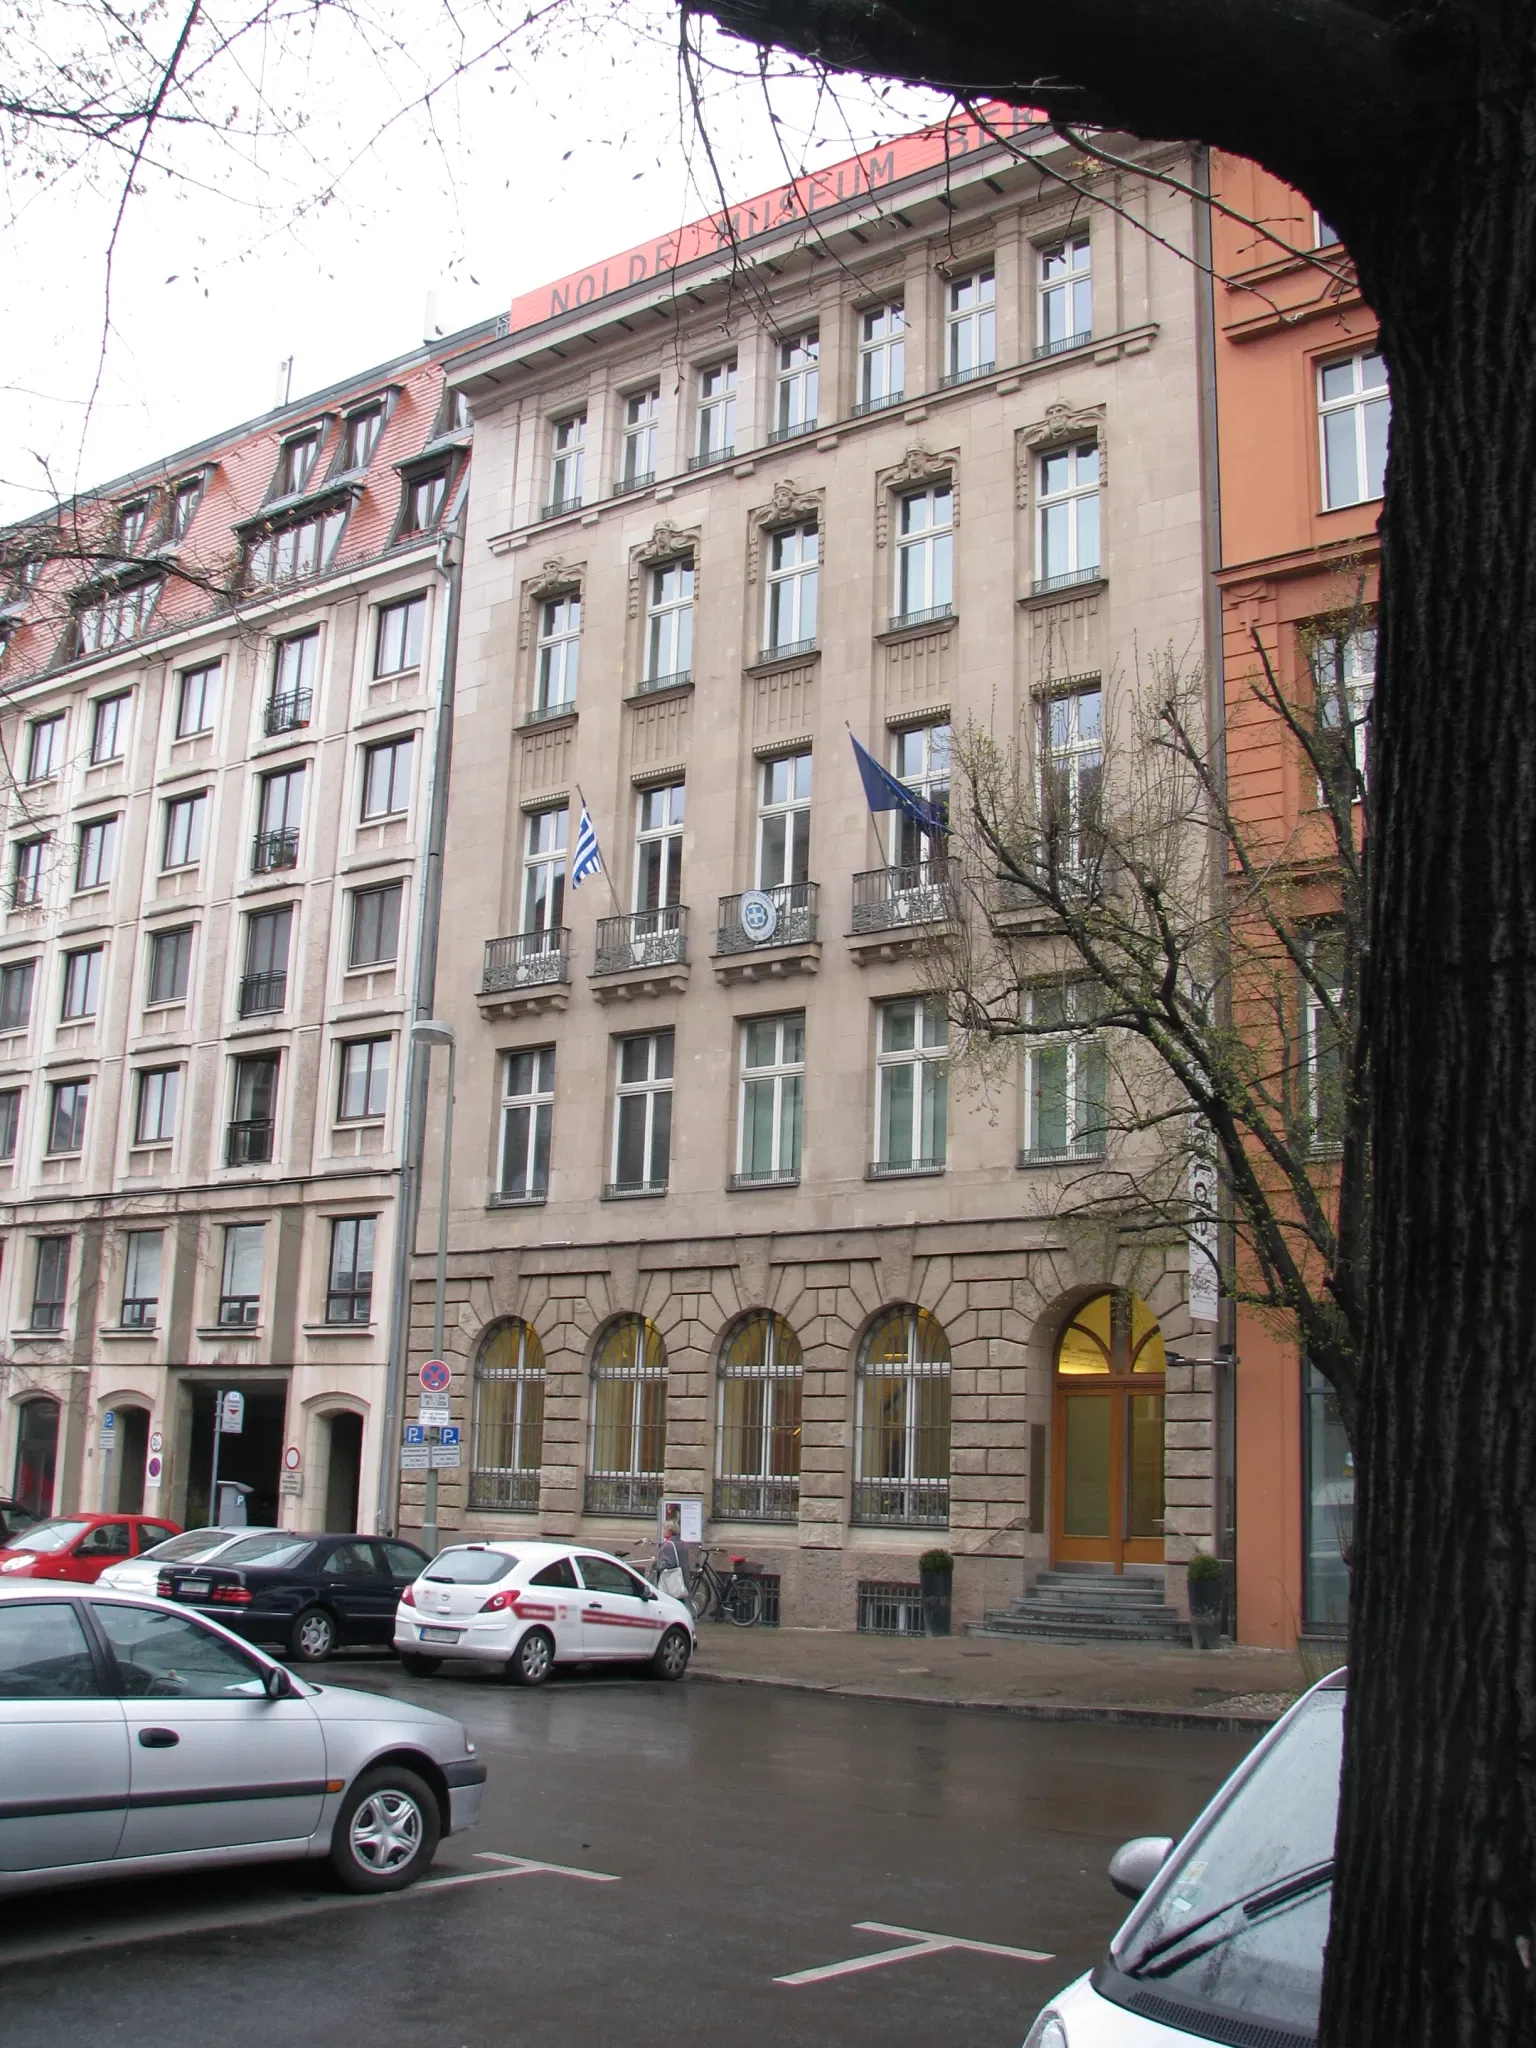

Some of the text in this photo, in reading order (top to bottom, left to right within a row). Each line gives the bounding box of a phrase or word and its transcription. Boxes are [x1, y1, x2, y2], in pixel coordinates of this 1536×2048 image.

[550, 239, 675, 317] NOLDE
[717, 151, 895, 250] MUSEUM
[407, 1427, 419, 1442] P
[443, 1429, 454, 1444] P
